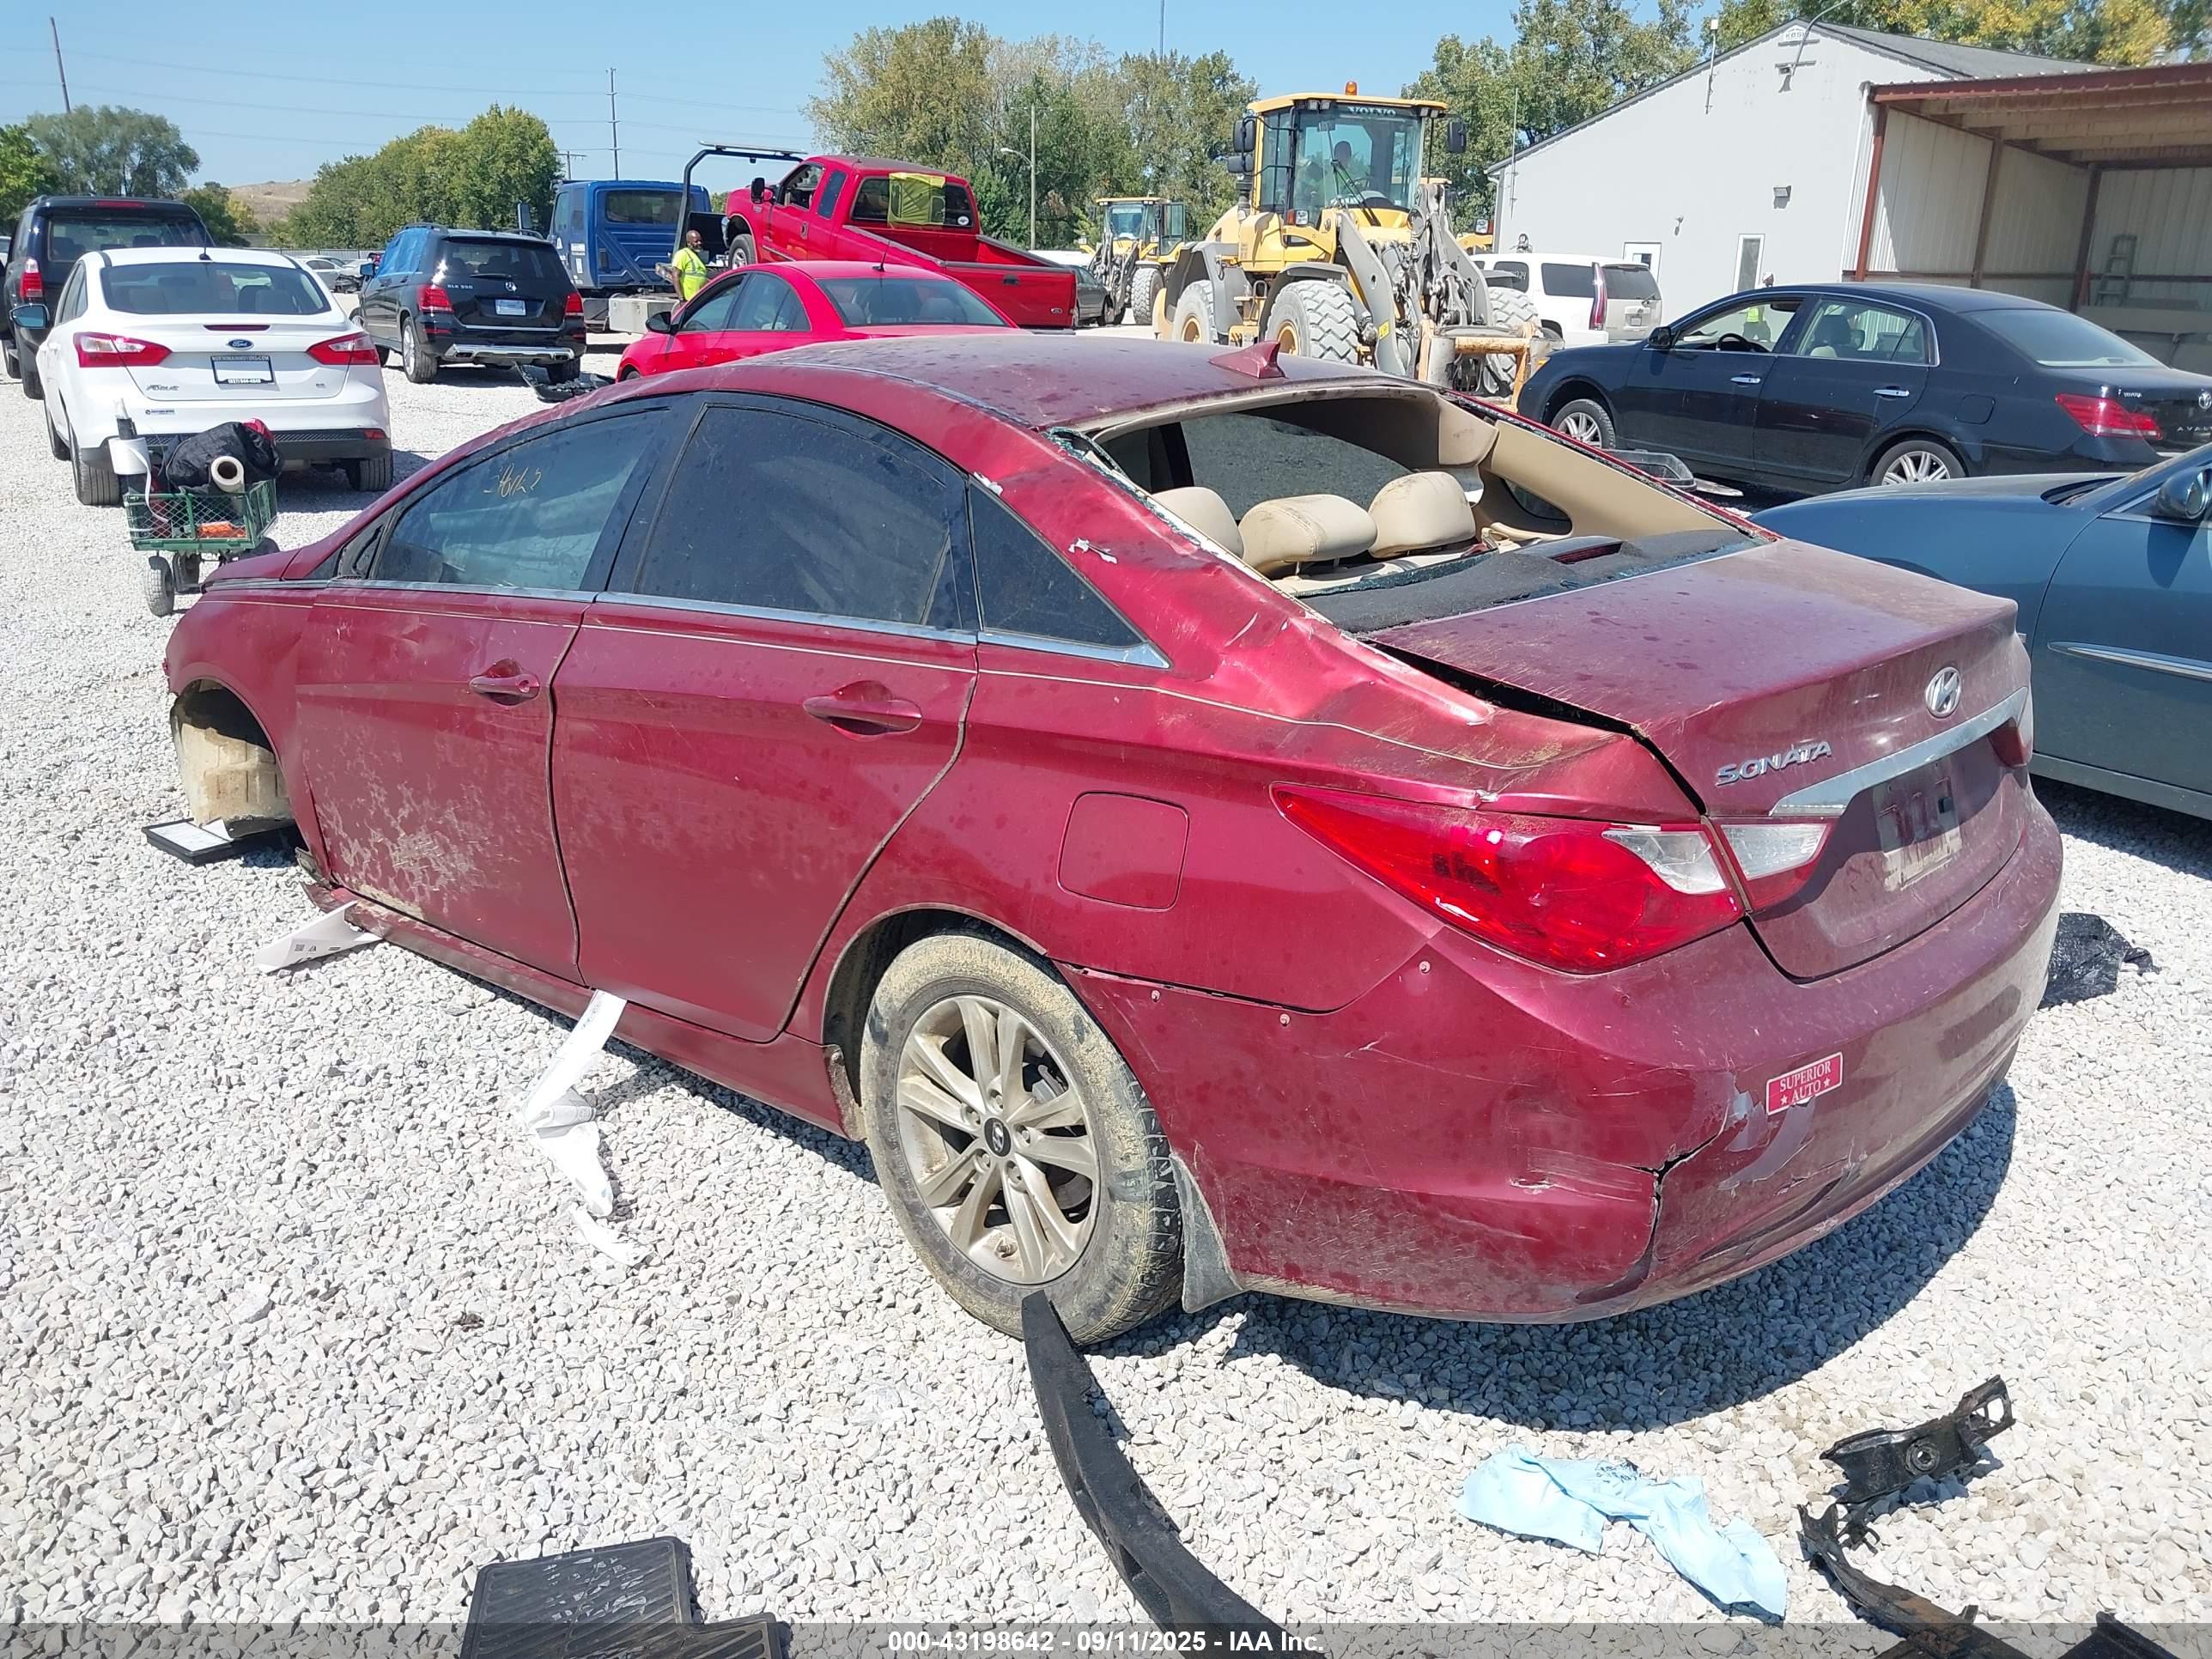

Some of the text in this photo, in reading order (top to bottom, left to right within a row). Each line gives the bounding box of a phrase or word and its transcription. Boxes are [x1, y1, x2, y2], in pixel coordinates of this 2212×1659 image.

[1347, 106, 1396, 116] VOLVO
[1716, 741, 1832, 787] SONATA
[1779, 1060, 1832, 1093] SUPERIOR
[1790, 1079, 1821, 1103] AUTO
